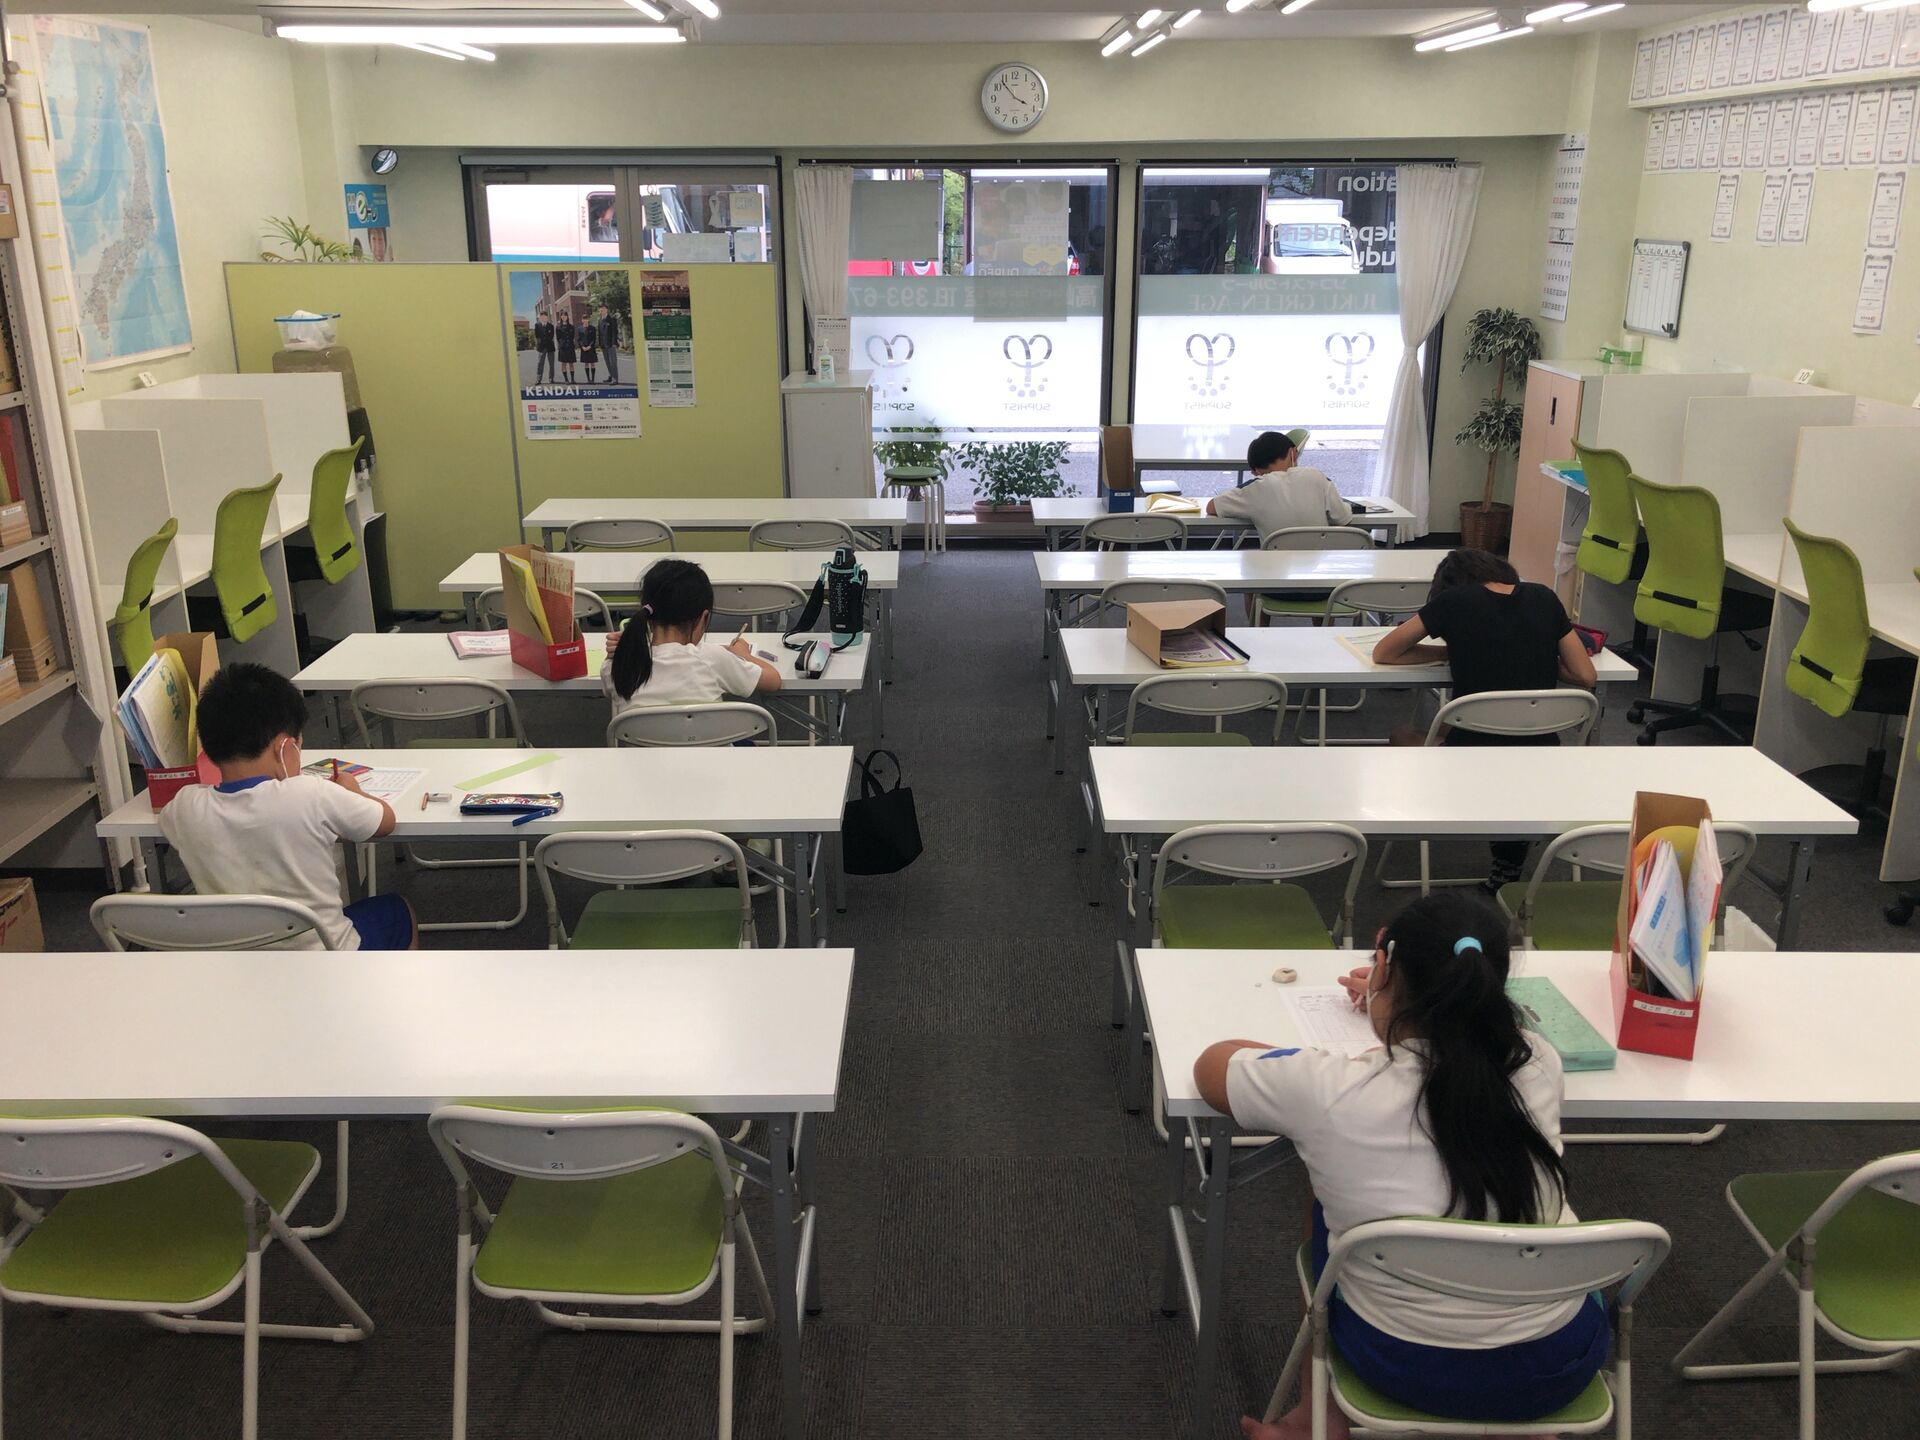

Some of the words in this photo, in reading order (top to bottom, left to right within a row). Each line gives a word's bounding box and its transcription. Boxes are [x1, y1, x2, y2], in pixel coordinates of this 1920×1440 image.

[1012, 71, 1019, 80] 12
[1031, 82, 1036, 90] 2
[991, 95, 996, 103] 9
[1034, 93, 1040, 102] 3
[995, 106, 1000, 115] 8
[1003, 114, 1007, 122] 7
[1012, 116, 1017, 124] 6
[1024, 114, 1028, 122] 5
[1799, 371, 1810, 381] 10
[525, 385, 580, 397] KENDAI
